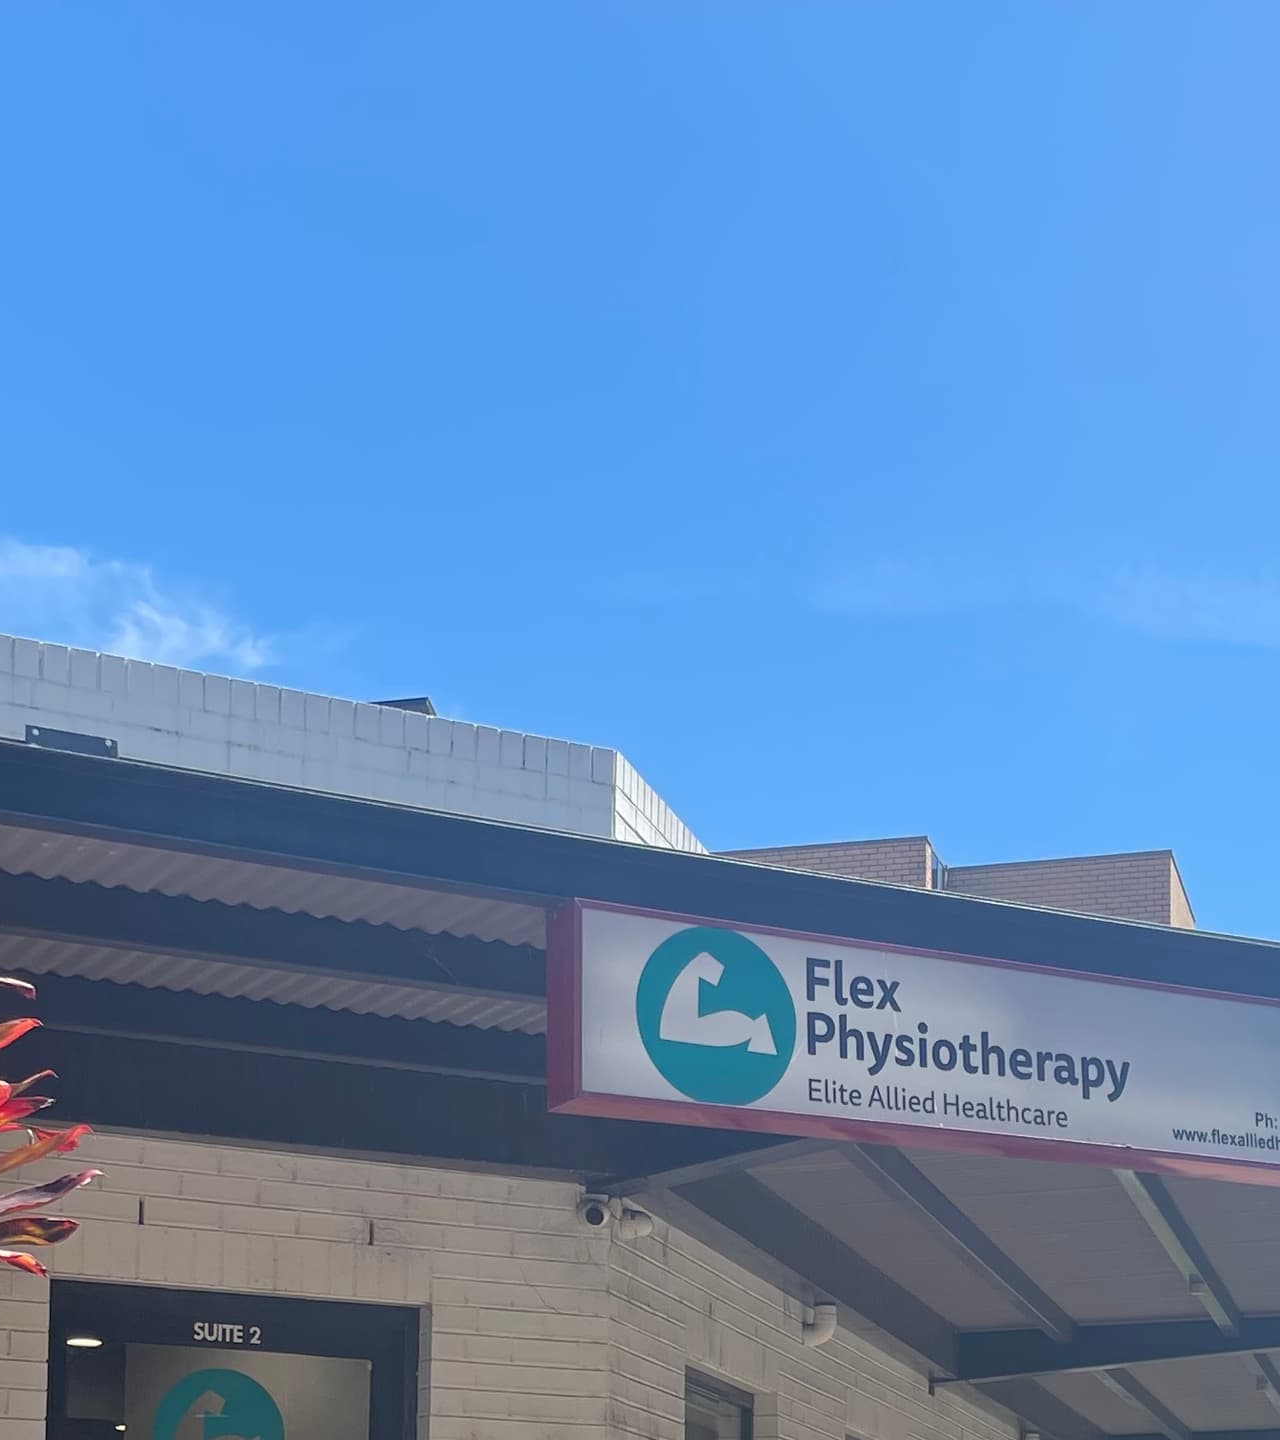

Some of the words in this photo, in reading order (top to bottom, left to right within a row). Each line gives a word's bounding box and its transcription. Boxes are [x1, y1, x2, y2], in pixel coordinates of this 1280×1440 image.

[806, 957, 902, 1012] Flex
[807, 1012, 1130, 1102] Physiotherapy
[808, 1078, 862, 1106] Elite
[868, 1085, 936, 1114] Allied
[943, 1093, 1068, 1128] Healthcare
[1255, 1112, 1278, 1129] Ph:
[193, 1322, 244, 1344] SUITE
[250, 1327, 262, 1345] 2
